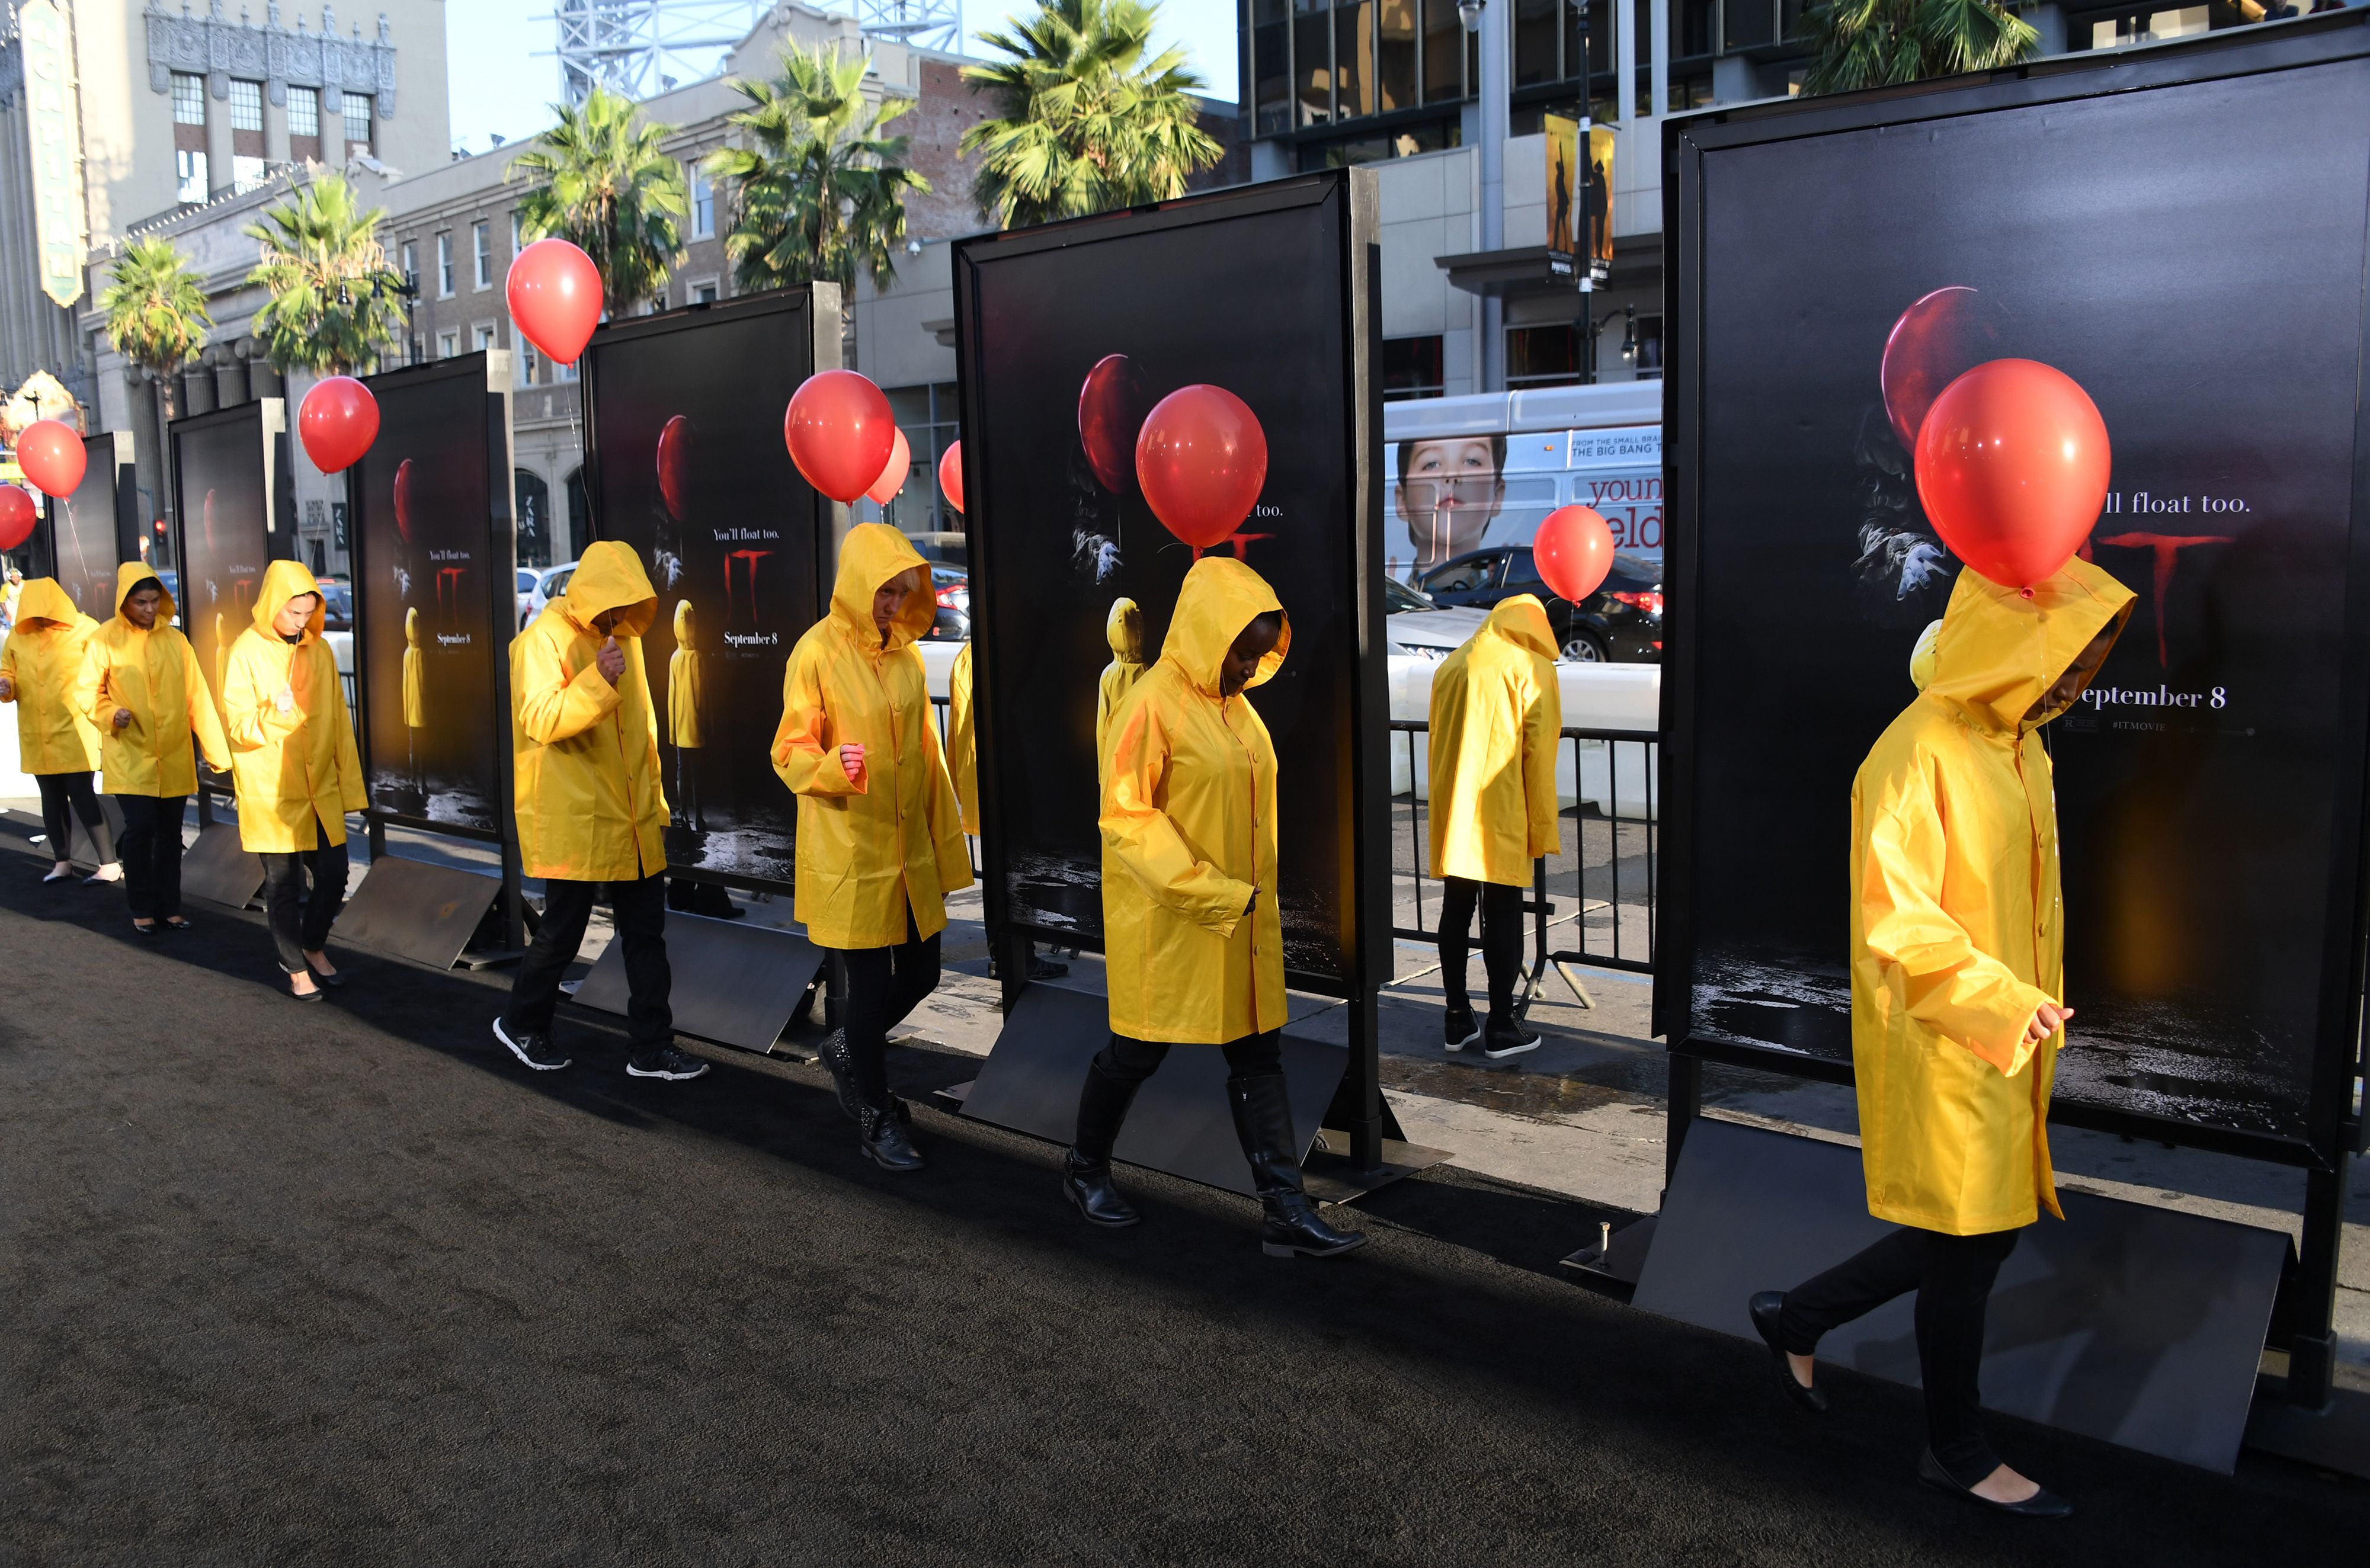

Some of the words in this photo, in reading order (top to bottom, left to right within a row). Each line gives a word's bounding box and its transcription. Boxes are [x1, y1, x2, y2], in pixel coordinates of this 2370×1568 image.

[1613, 436, 1639, 444] SMALL
[1572, 448, 1593, 457] THE
[1596, 446, 1615, 457] BIG
[1619, 444, 1652, 455] BANG
[1586, 477, 1663, 509] youn
[1257, 504, 1283, 517] too.
[2131, 492, 2192, 514] float
[2201, 495, 2251, 513] too.
[713, 527, 738, 541] You'll
[741, 527, 760, 540] float
[763, 528, 780, 539] too.
[1606, 507, 1664, 549] eld
[724, 549, 775, 623] IT
[437, 567, 467, 626] IT
[436, 632, 466, 647] September
[466, 633, 471, 644] 8
[724, 631, 771, 648] September
[771, 632, 778, 645] 8
[2076, 684, 2202, 710] eptember
[2209, 687, 2226, 709] 8
[2113, 721, 2166, 732] #ITMOVIE
